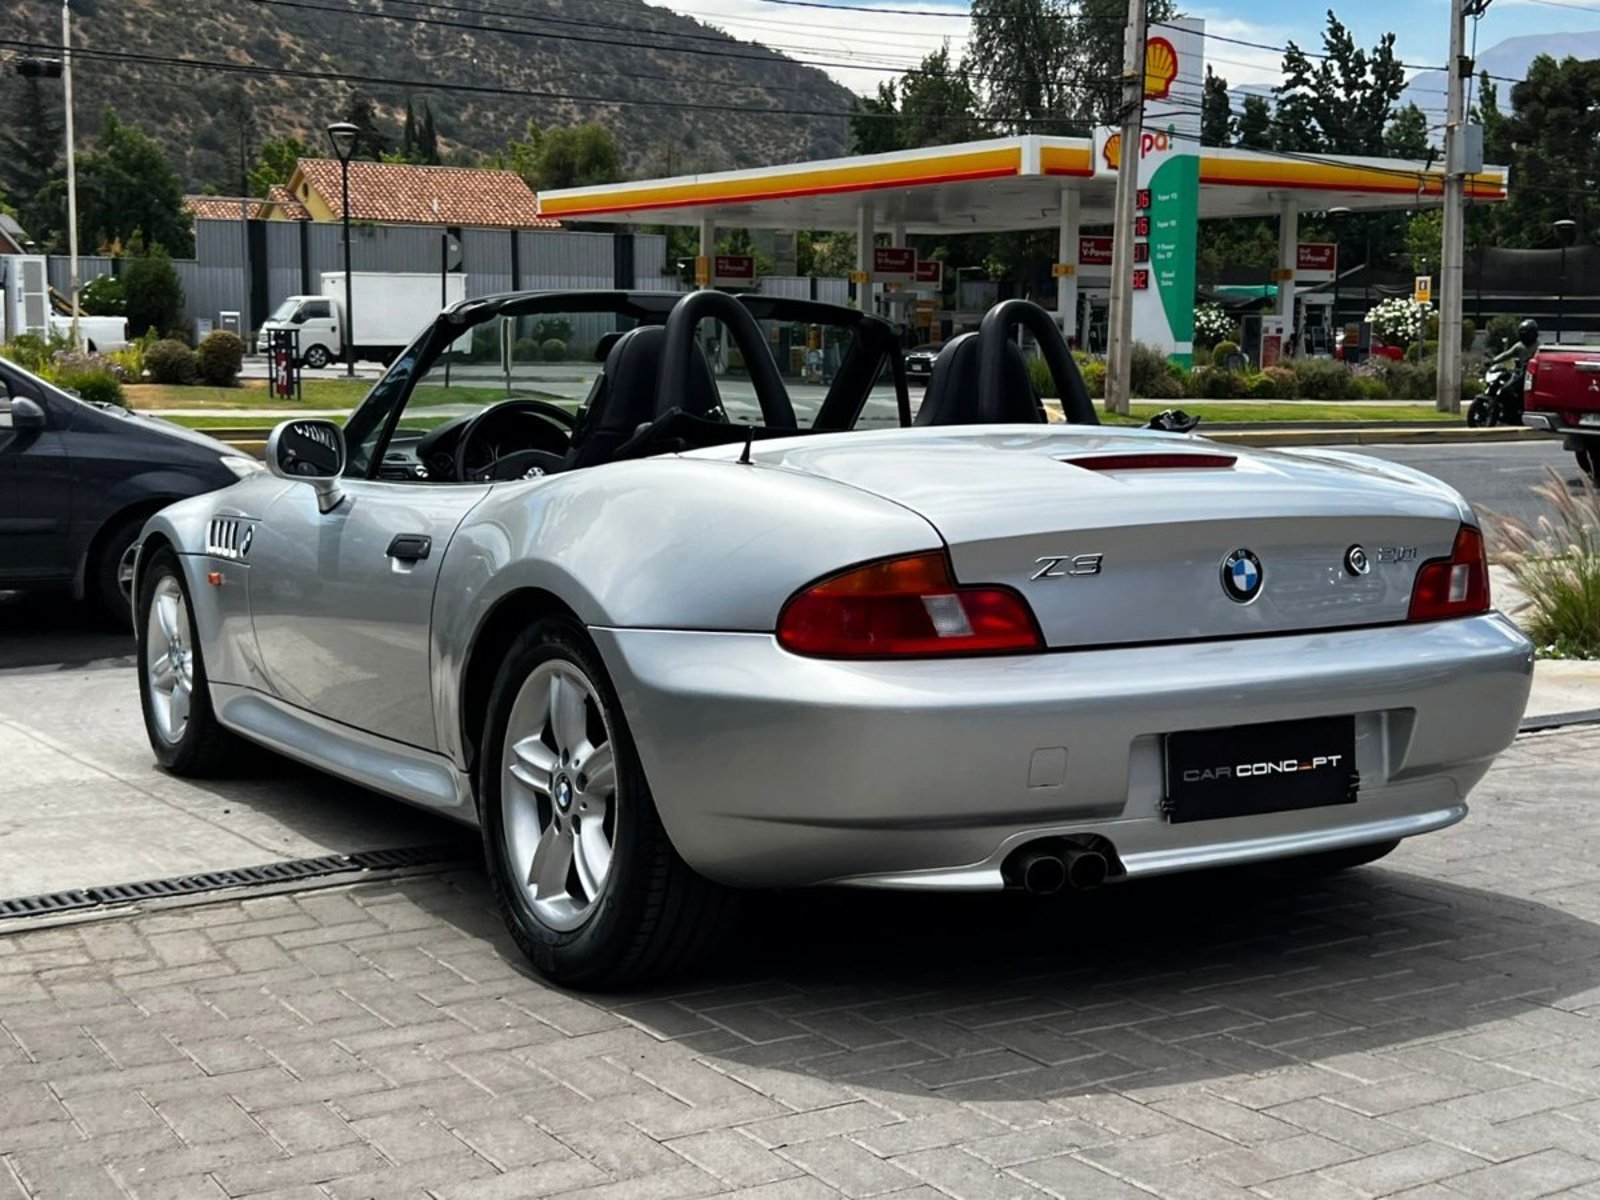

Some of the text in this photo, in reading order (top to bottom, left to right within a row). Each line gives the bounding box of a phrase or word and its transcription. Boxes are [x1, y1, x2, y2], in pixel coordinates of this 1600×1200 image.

[1140, 123, 1176, 160] pa!
[1082, 248, 1113, 257] V-Powe
[1030, 552, 1104, 580] Z3
[1183, 766, 1232, 782] CAR
